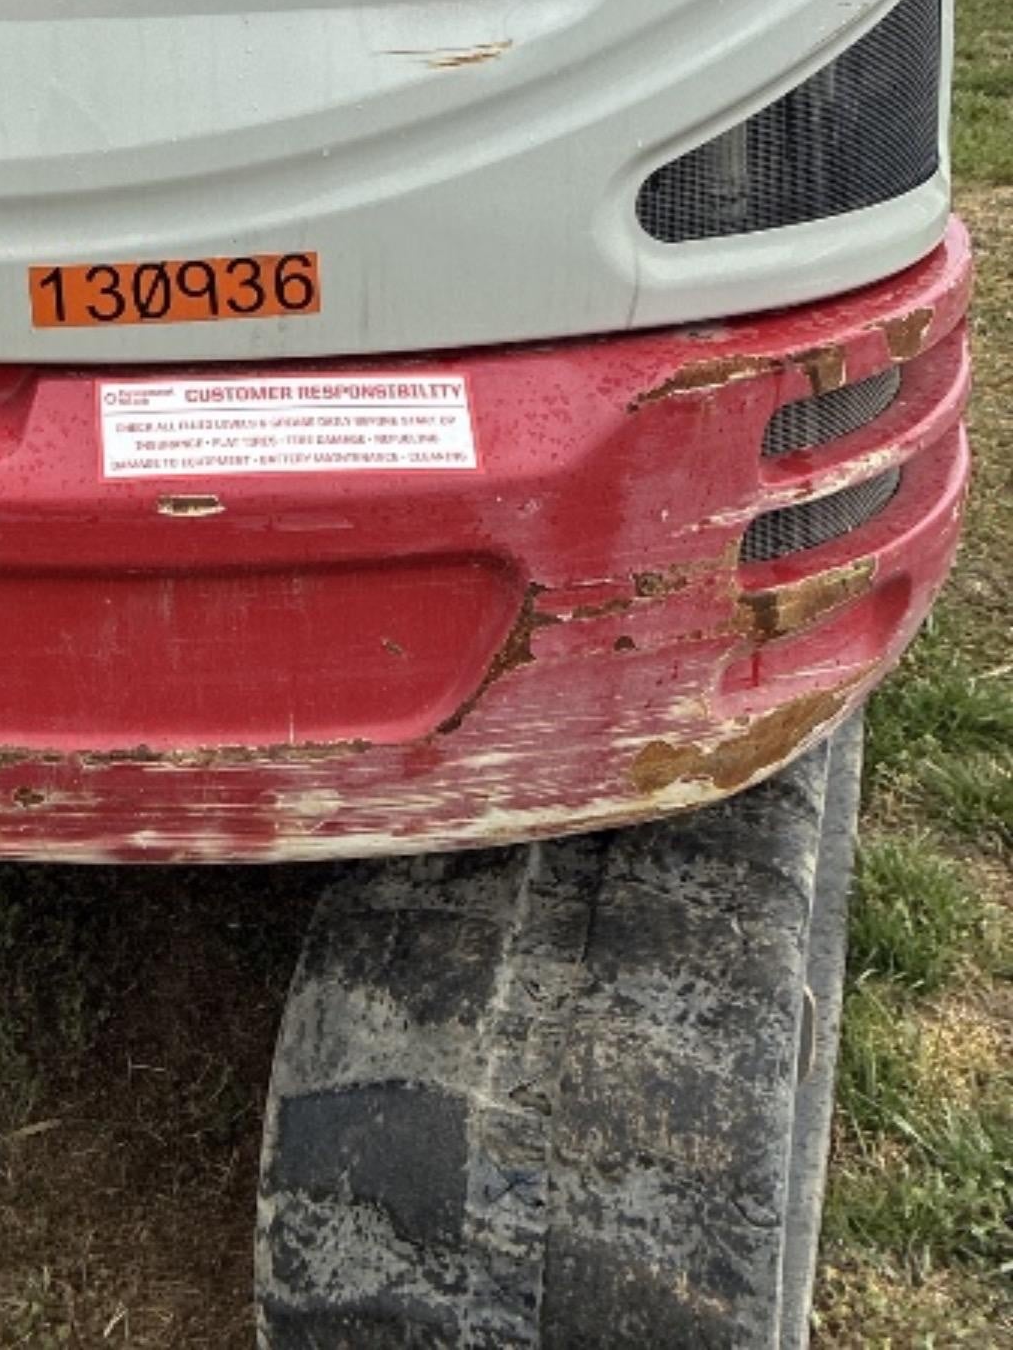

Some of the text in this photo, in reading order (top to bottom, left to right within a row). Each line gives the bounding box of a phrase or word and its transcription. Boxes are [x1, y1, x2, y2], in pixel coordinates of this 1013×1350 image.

[39, 253, 314, 322] 130936
[185, 383, 462, 403] CUSTOMER RESPONSIBILITY
